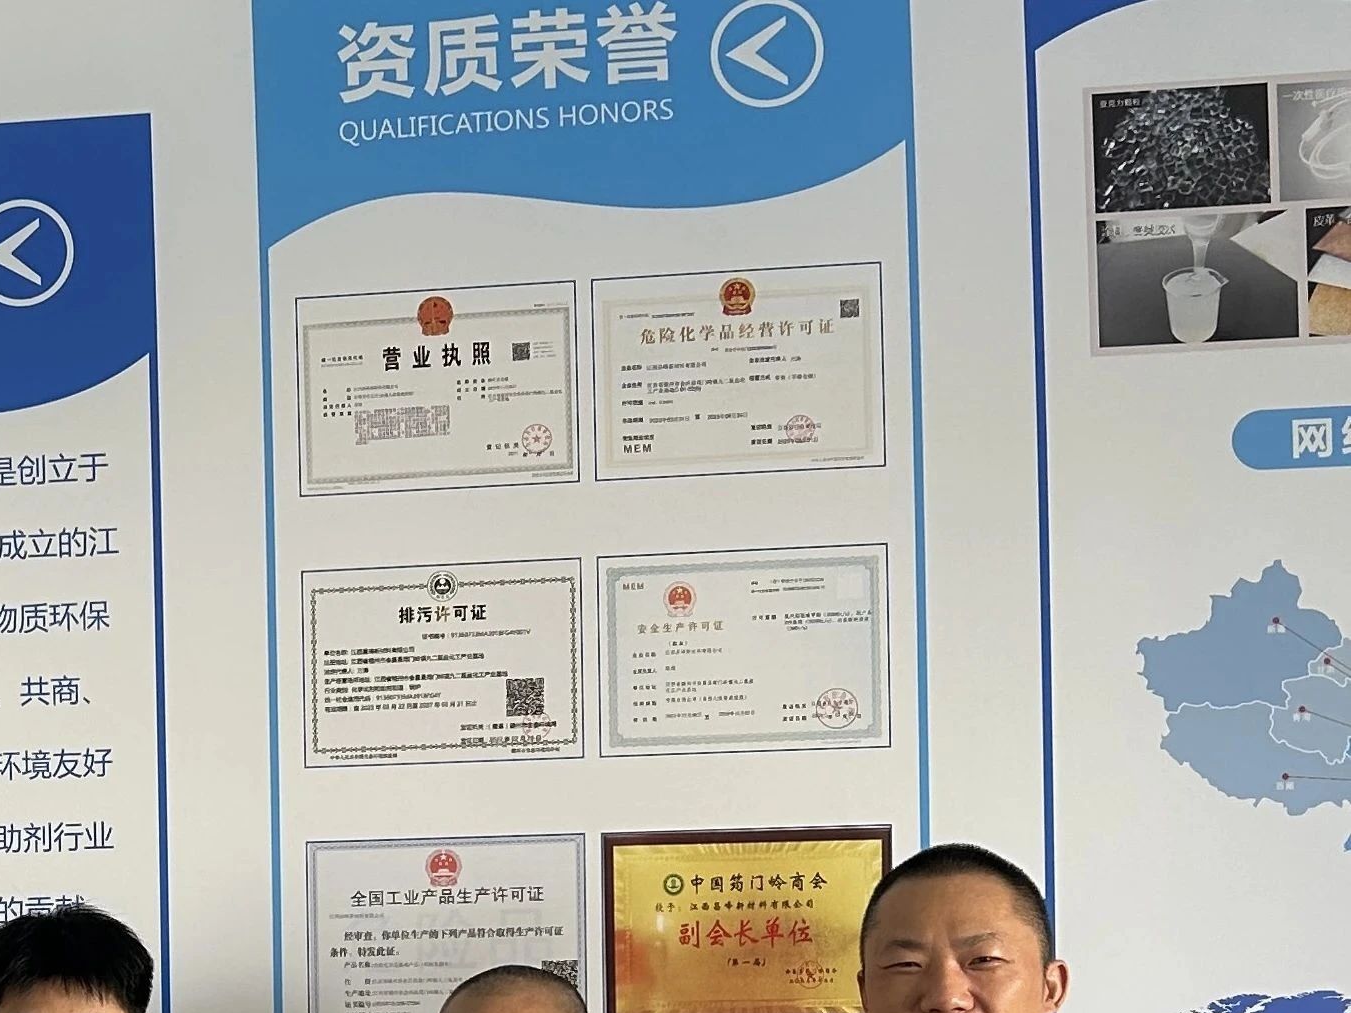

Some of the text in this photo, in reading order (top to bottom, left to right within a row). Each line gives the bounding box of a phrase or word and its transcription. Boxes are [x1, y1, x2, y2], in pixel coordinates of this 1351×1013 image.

[338, 2, 678, 103] 资质荣誉
[339, 99, 674, 146] QUALIFICATIONS HONORS
[640, 318, 835, 345] 危险化学品经营许可证
[382, 342, 491, 371] 营业执照
[1292, 416, 1351, 459] 网
[399, 604, 487, 624] 排污许可证
[637, 620, 724, 635] 安全生产许可证
[691, 871, 828, 895] 中国筠门岭商会
[350, 886, 545, 908] 全国工业产品生产许可证
[690, 898, 815, 912] 江西昌峰新材料有限公司
[679, 916, 814, 949] 副会长单位
